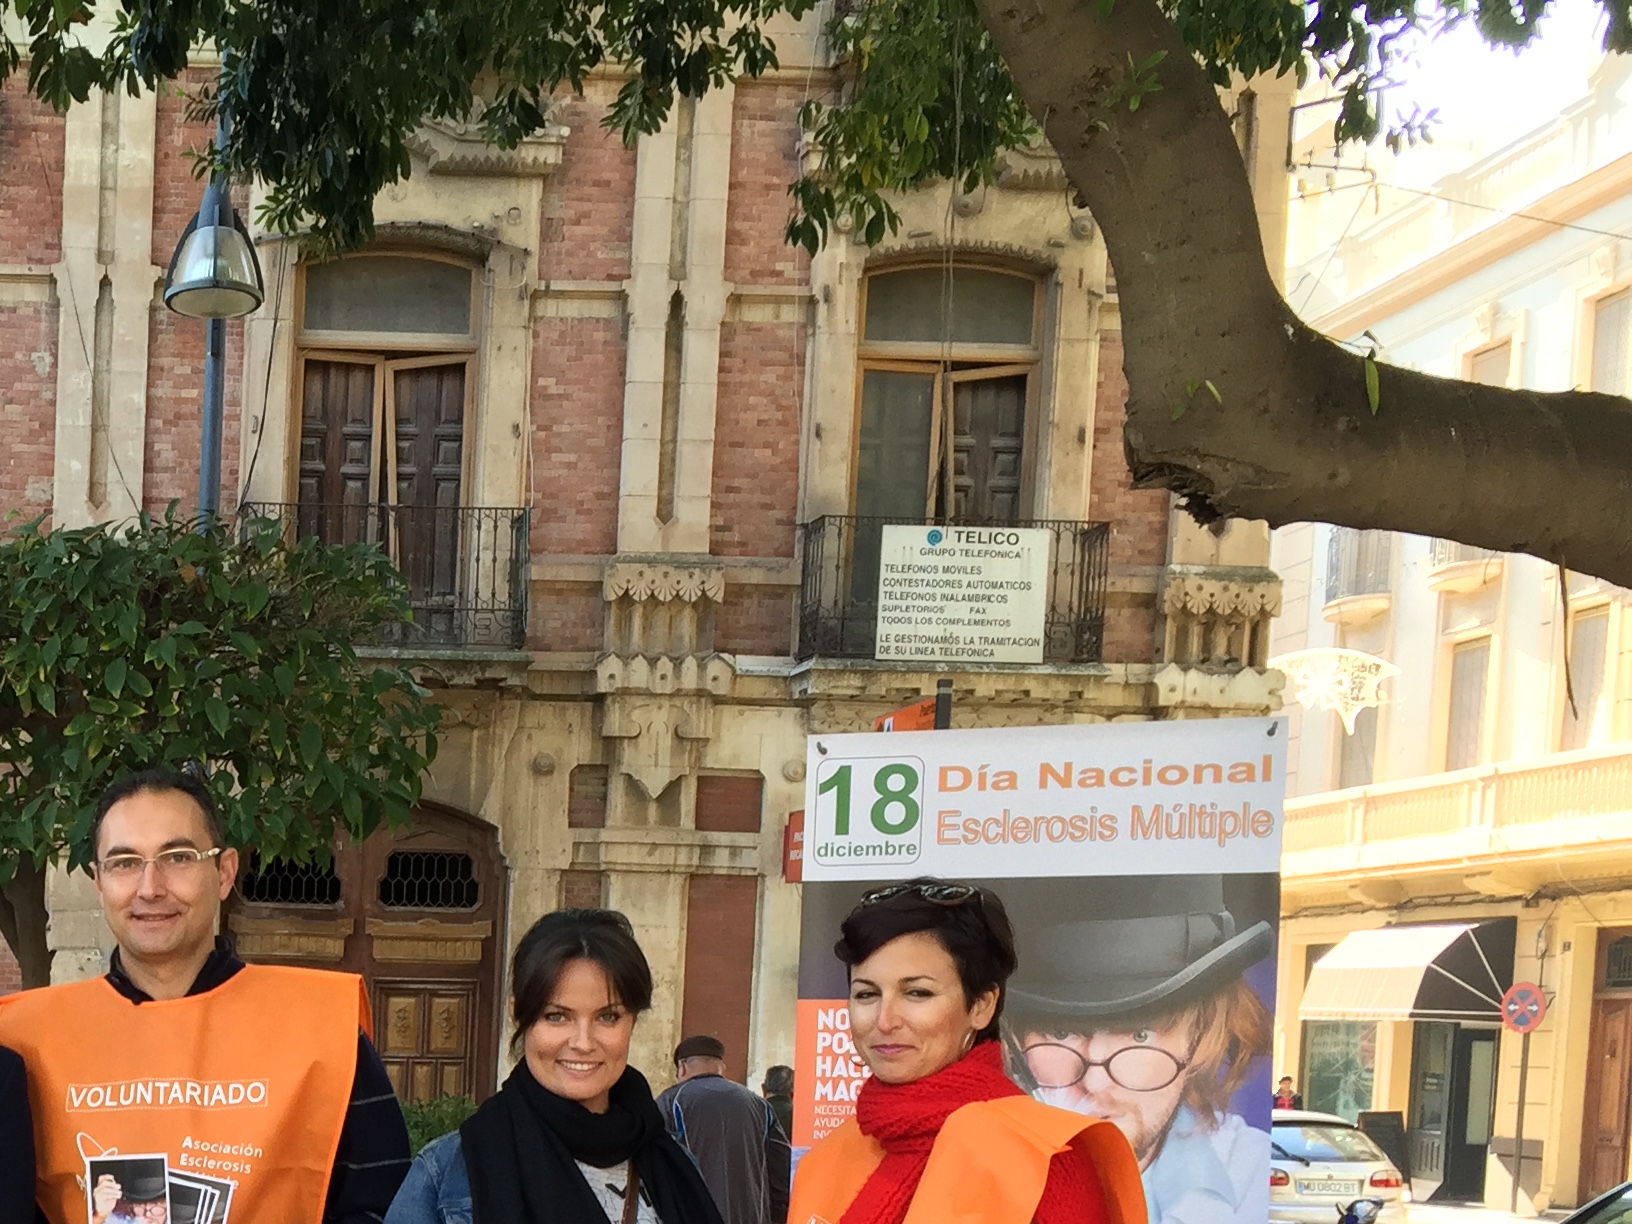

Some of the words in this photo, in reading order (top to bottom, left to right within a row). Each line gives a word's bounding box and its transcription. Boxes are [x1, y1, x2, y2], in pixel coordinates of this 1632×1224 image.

[955, 530, 1020, 546] TELICO
[919, 547, 956, 558] GRUPO
[959, 548, 1021, 559] TELEFONICA
[885, 563, 939, 575] TELEFONOS
[942, 565, 982, 576] MOVILES
[882, 577, 963, 589] CONTESTADORES
[965, 580, 1032, 591] AUTOMATICOS
[883, 591, 937, 602] TELEFONOS
[940, 592, 1008, 604] INALAMBRICOS
[881, 604, 945, 614] SUPLETORIOS
[969, 606, 987, 615] FAX
[881, 616, 913, 625] TODOS
[915, 617, 933, 625] LOS
[935, 617, 1011, 628] COMPLEMENTOS
[879, 634, 891, 643] LE
[894, 633, 960, 646] GESTIONAMOS
[963, 636, 975, 645] LA
[978, 637, 1040, 648] TRAMITACION
[879, 645, 891, 655] DE
[894, 646, 907, 655] SU
[909, 646, 936, 656] LINEA
[939, 647, 995, 658] TELEFONICA
[938, 764, 1019, 793] Día
[1038, 754, 1273, 790] Nacional
[819, 763, 920, 836] 18
[936, 806, 1118, 846] Esclerosis
[1130, 802, 1275, 848] Múltiple
[817, 840, 917, 858] diciembre
[817, 1008, 850, 1031] NO
[70, 1081, 266, 1107] VOLUNTARIADO
[814, 1105, 857, 1115] NECESITA
[182, 1136, 263, 1158] Asociación
[179, 1154, 252, 1174] Esclerosis
